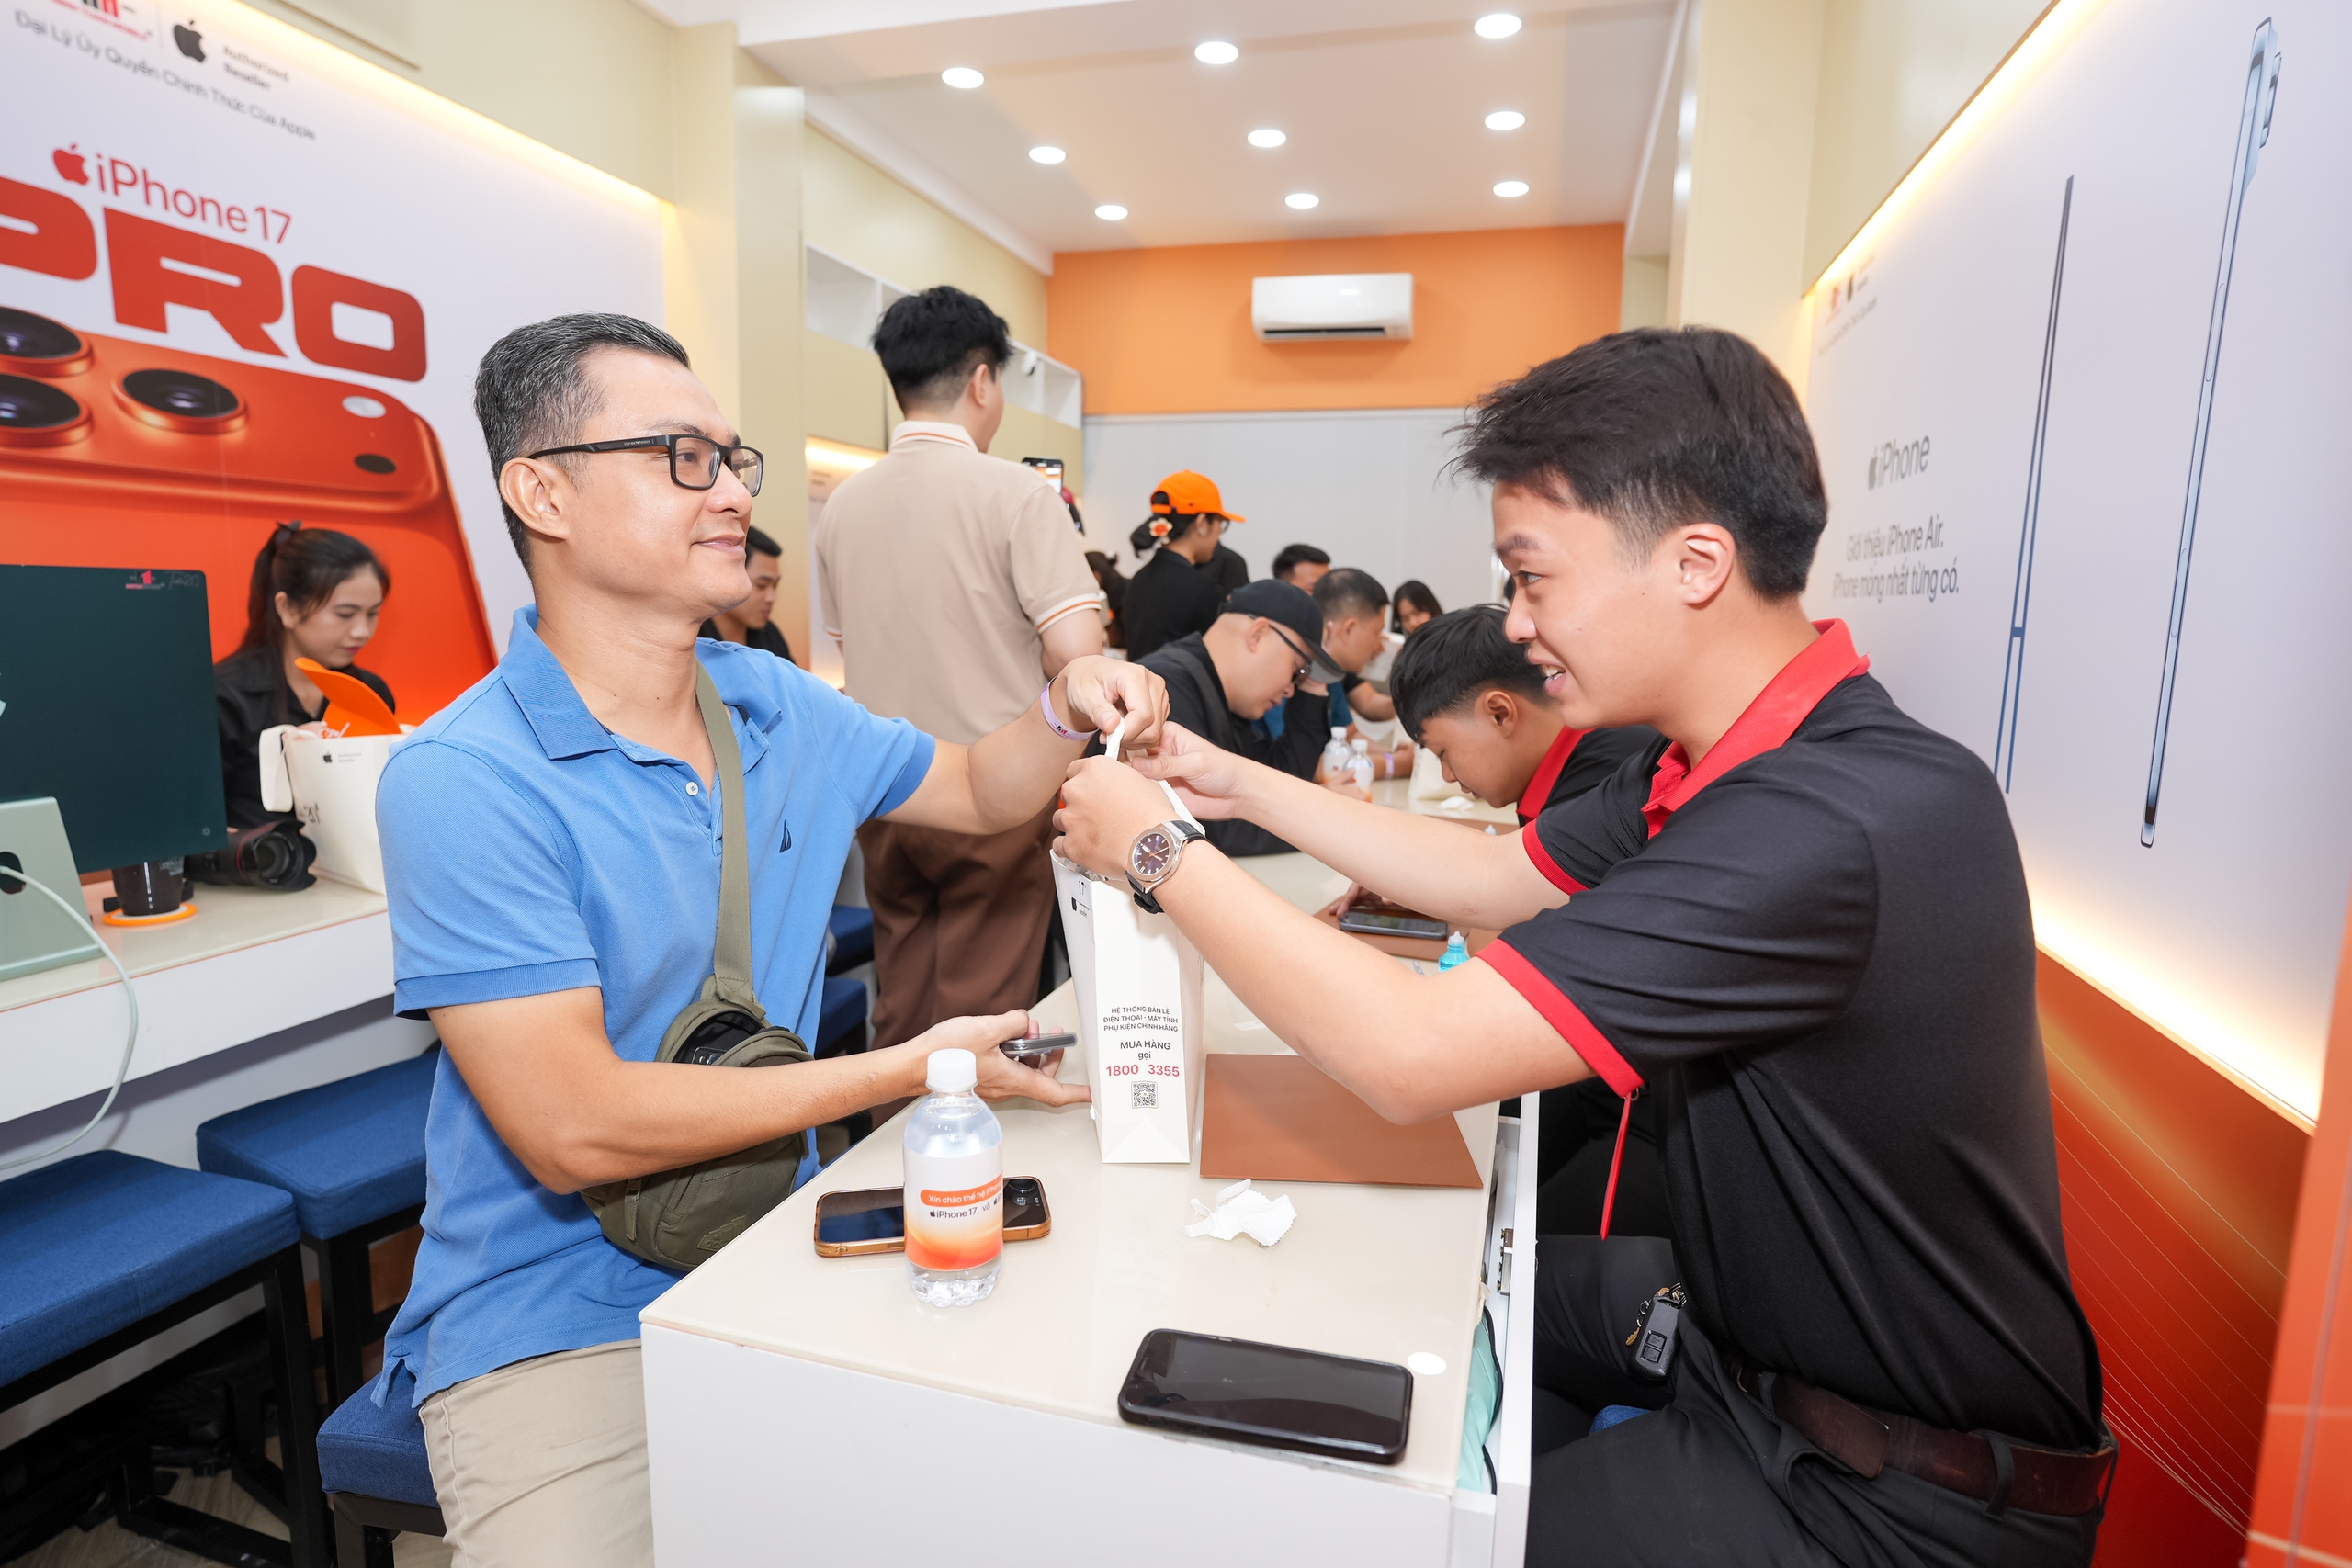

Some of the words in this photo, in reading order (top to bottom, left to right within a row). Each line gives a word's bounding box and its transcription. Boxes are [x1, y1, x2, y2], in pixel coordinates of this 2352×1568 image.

[96, 154, 249, 233] iPhone
[255, 206, 291, 244] 17
[1877, 435, 1930, 487] iPhone
[1925, 513, 1944, 550] Air.
[1940, 556, 1959, 594] có.
[1120, 1040, 1142, 1049] MUA
[1144, 1039, 1170, 1050] HÀNG
[1137, 1051, 1151, 1060] gọi
[1105, 1064, 1139, 1077] 1800
[1148, 1064, 1180, 1077] 3355
[928, 1194, 941, 1203] Xin
[942, 1195, 962, 1204] chào
[936, 1210, 967, 1218] iPhone
[968, 1207, 978, 1216] 17
[982, 1202, 991, 1212] và
